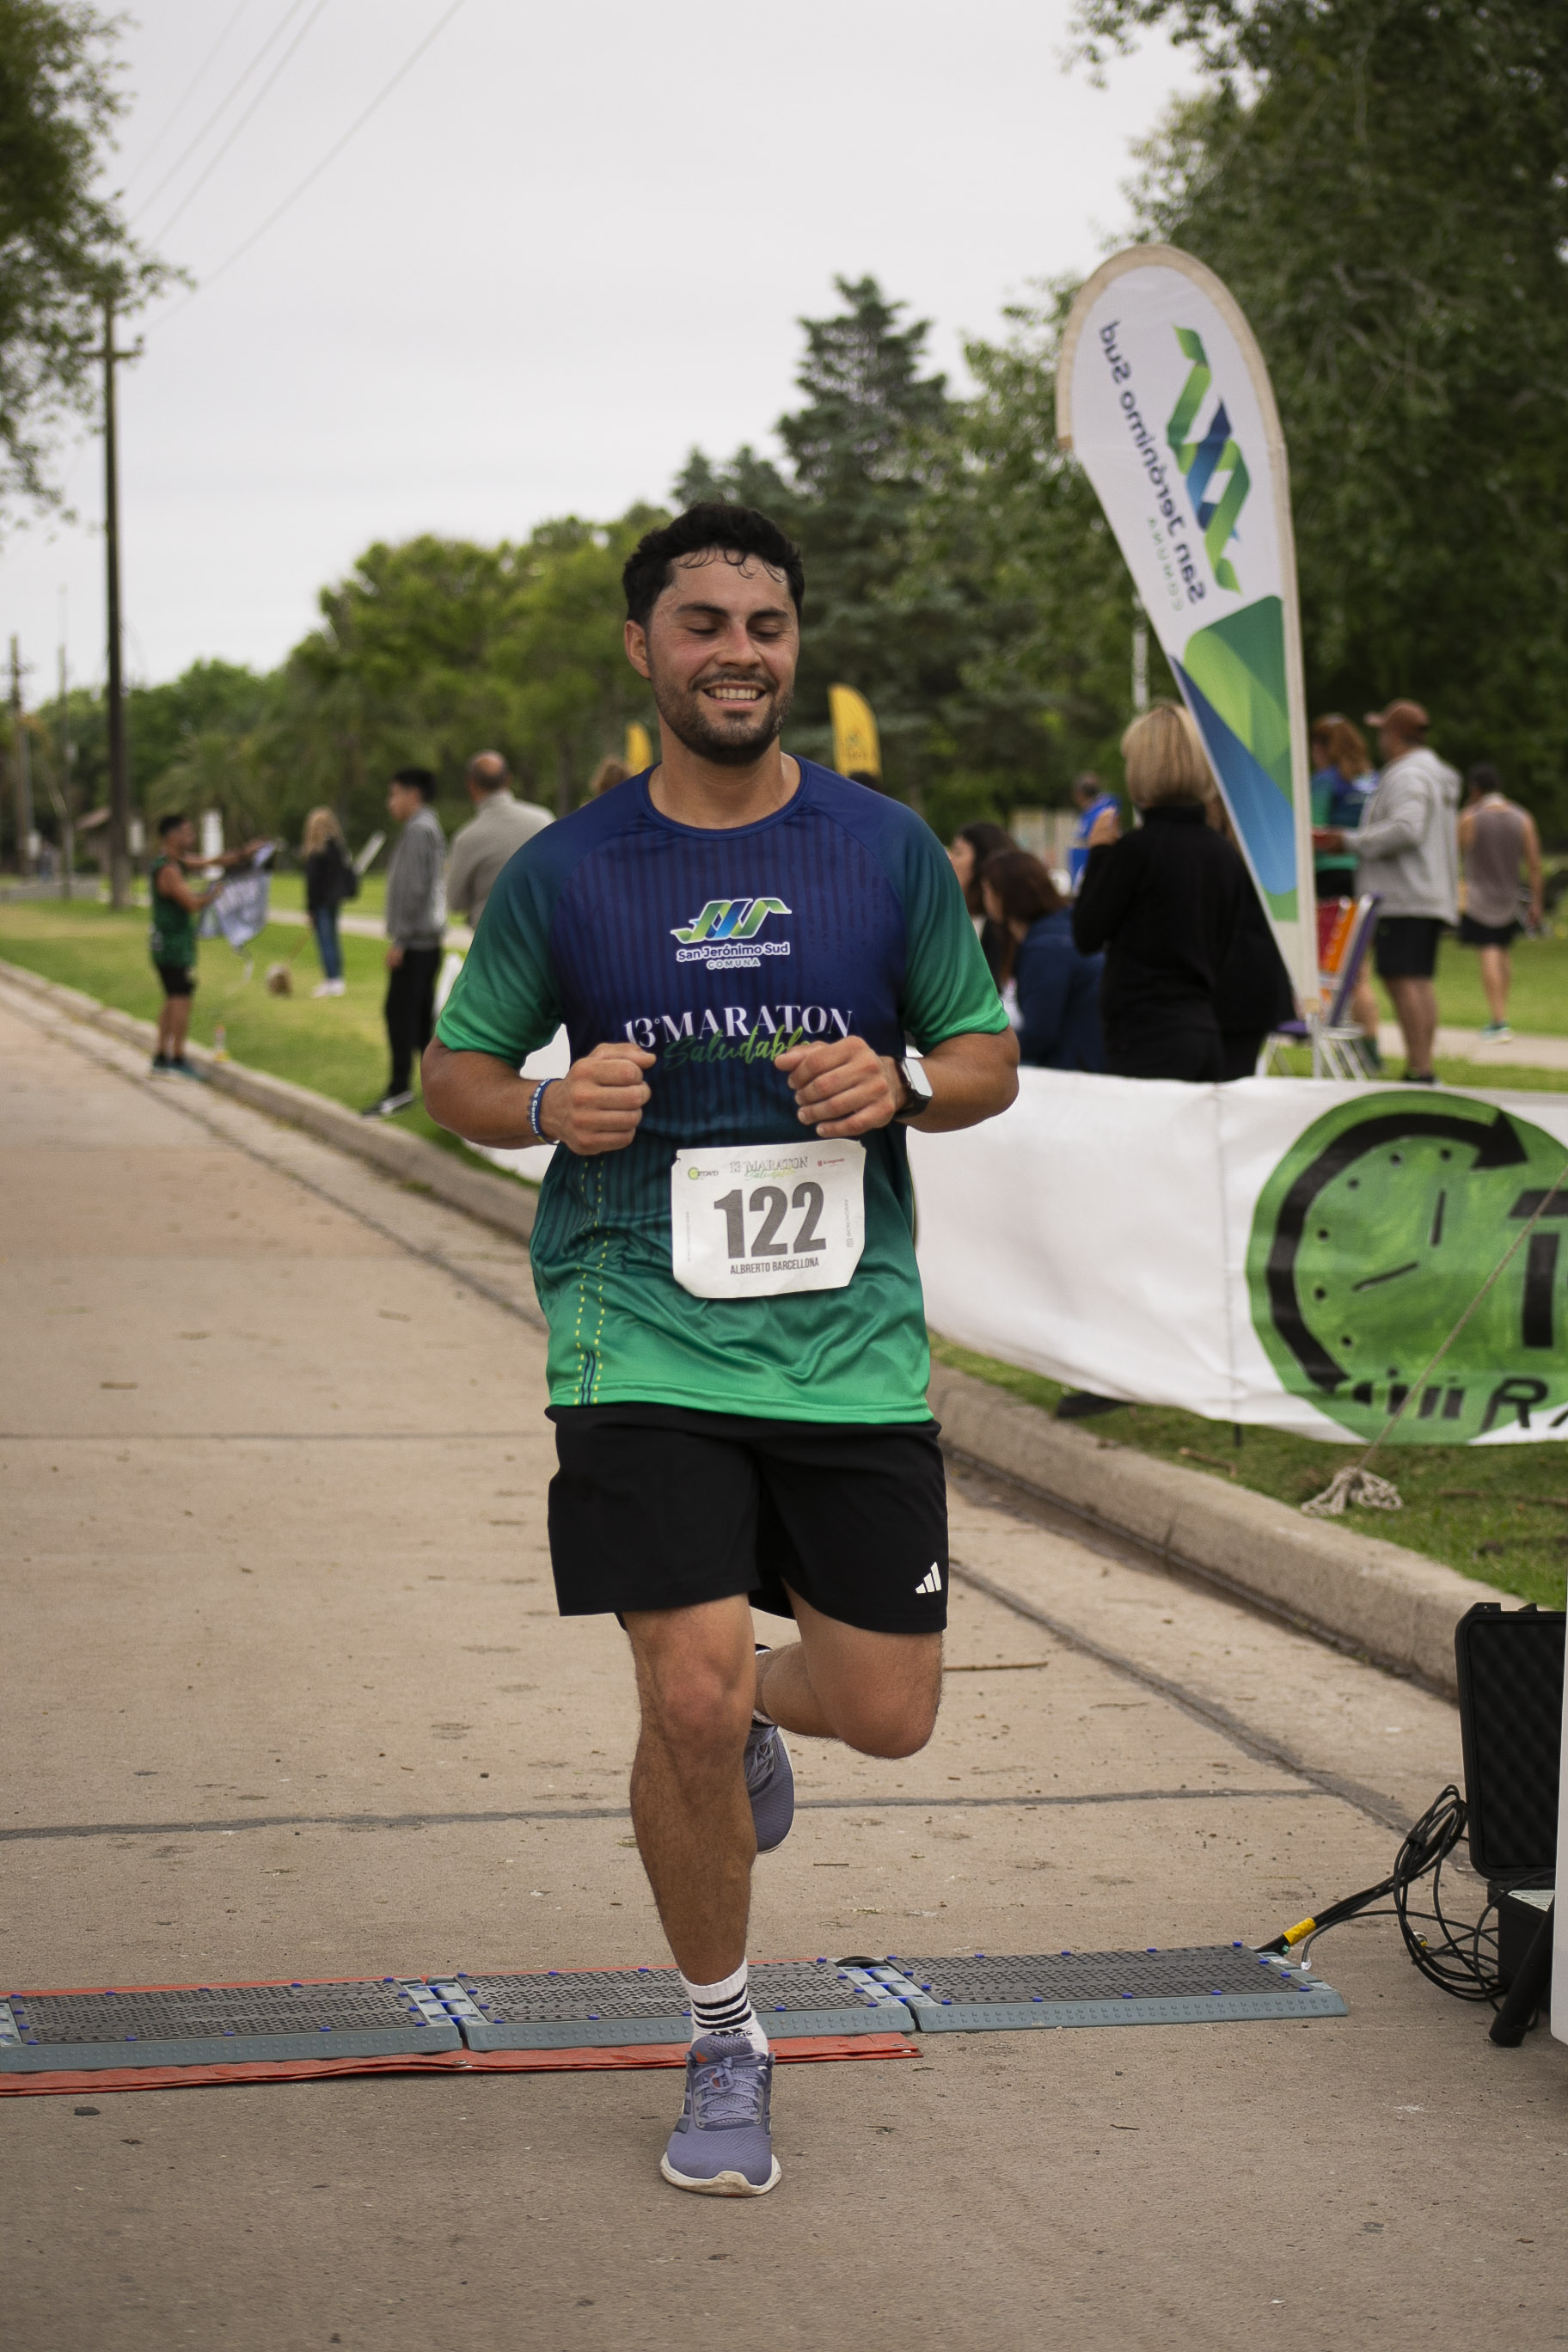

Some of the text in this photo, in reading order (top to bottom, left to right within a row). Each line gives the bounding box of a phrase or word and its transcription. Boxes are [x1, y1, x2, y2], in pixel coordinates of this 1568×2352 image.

[677, 941, 790, 961] San Jerónimo Sud
[707, 959, 761, 970] COMUNA
[661, 1005, 853, 1044] MARATON
[714, 1181, 827, 1259] 122
[730, 1257, 820, 1275] ALBRERTO BARCELLONA
